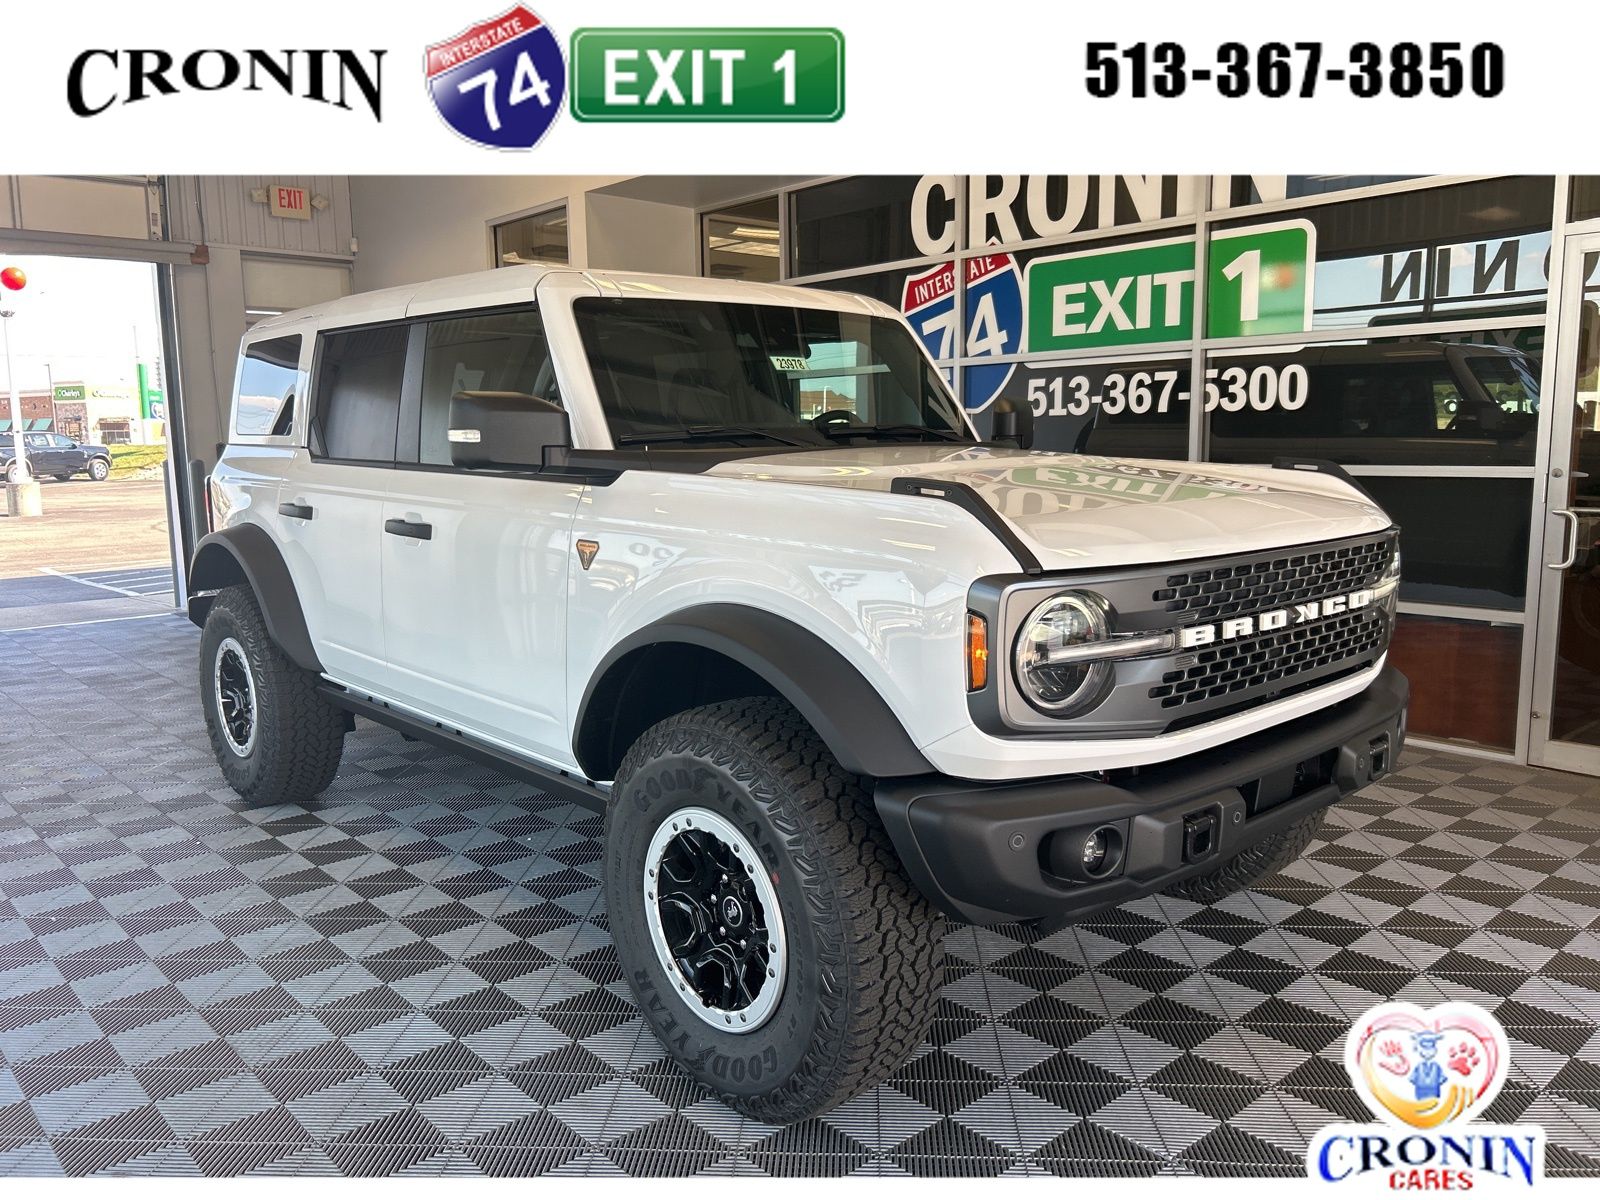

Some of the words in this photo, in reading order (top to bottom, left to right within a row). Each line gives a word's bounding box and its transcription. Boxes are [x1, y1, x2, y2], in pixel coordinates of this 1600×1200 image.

[277, 187, 304, 210] EXIT
[911, 175, 1288, 257] CRON
[914, 256, 996, 305] INTERATE
[1052, 269, 1196, 337] EXIT
[1221, 249, 1262, 322] 1
[775, 358, 806, 370] 23978
[921, 292, 1009, 381] 74
[1027, 364, 1309, 417] 513-367-5300
[1180, 588, 1372, 649] BRONCO
